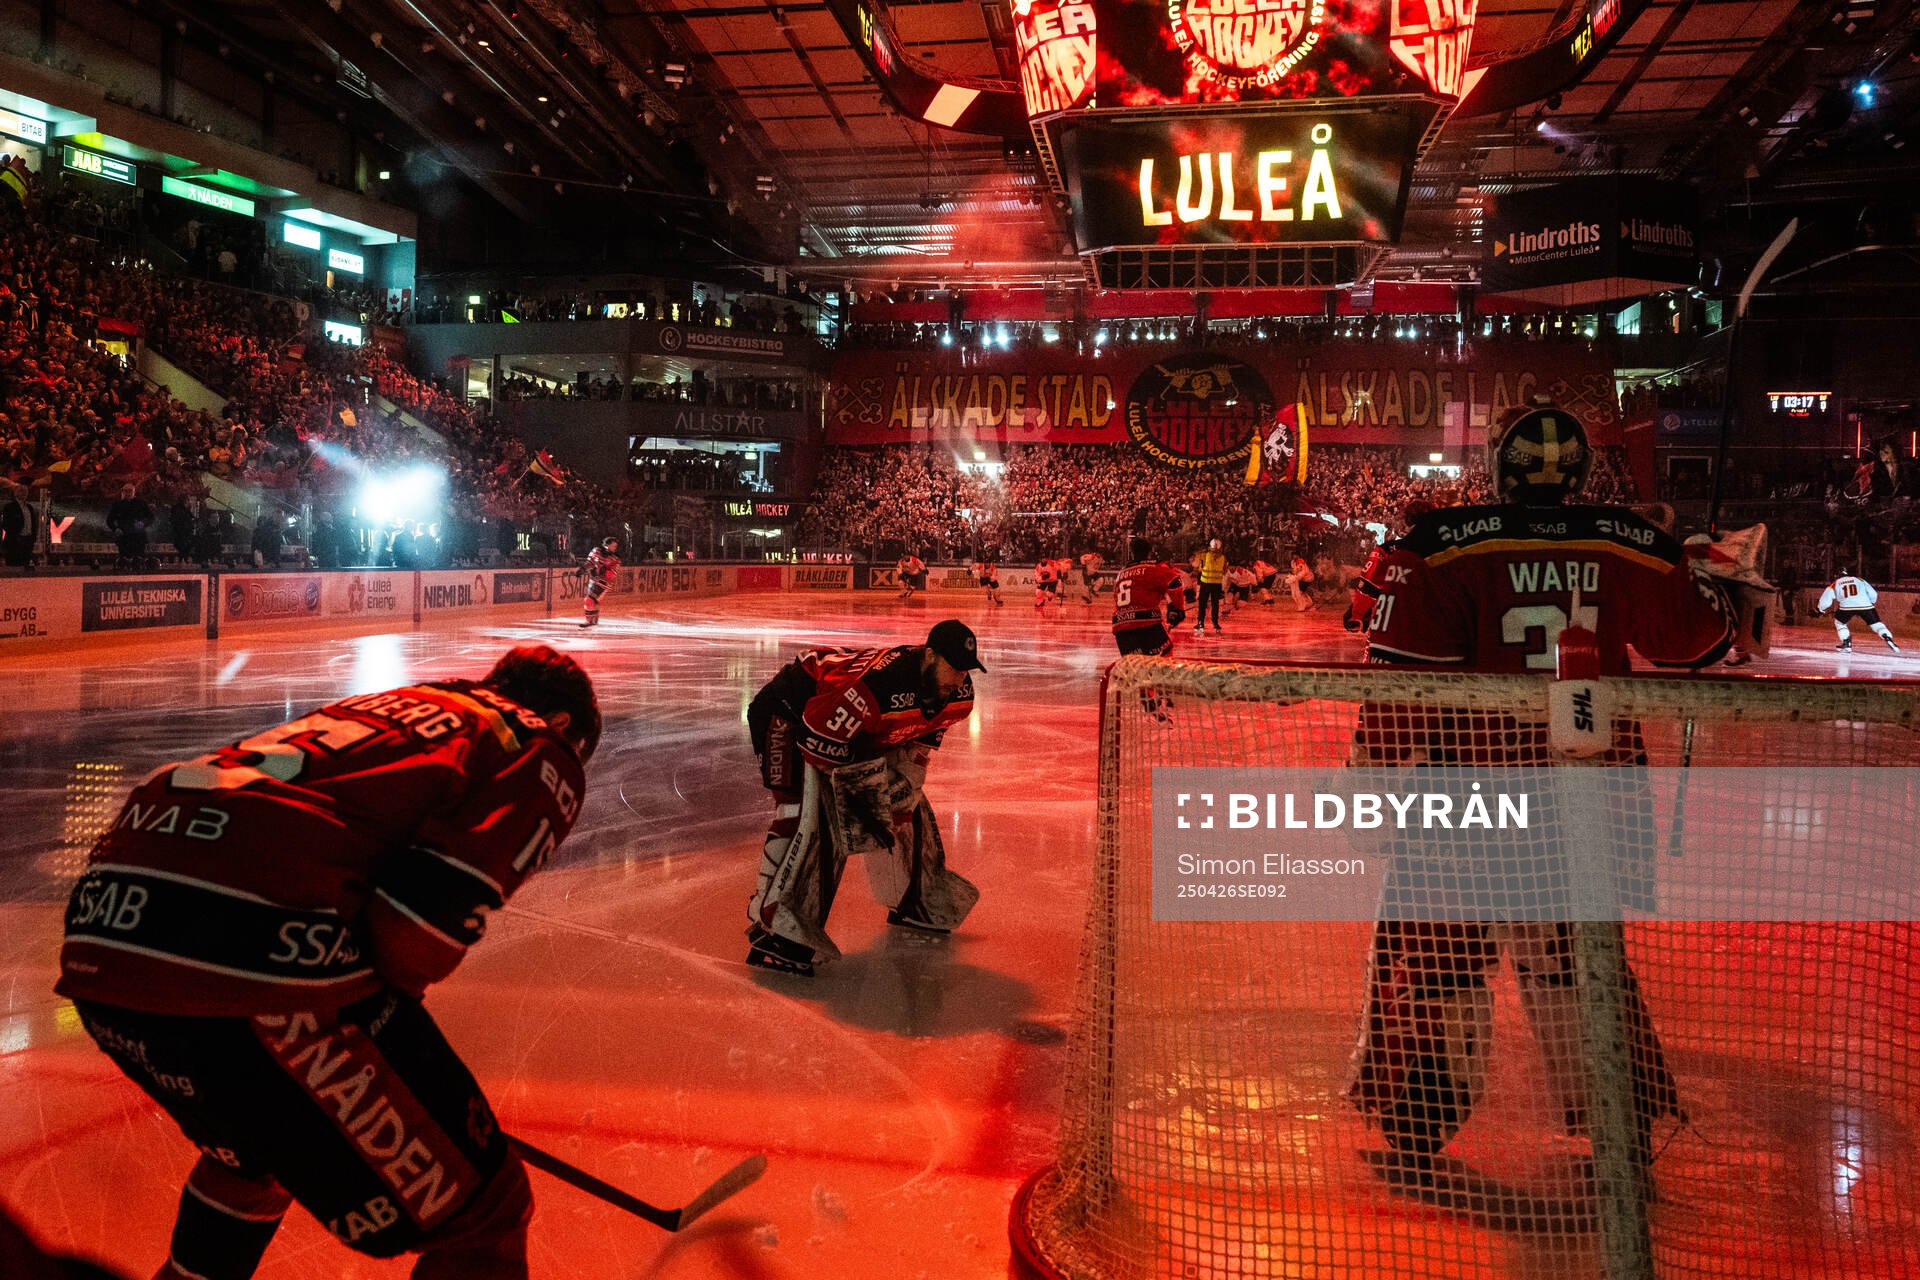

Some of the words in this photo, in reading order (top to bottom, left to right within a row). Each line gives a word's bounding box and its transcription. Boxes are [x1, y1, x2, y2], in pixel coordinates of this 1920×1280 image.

[1186, 10, 1306, 69] HOCKEY
[1187, 31, 1320, 90] HOCKEYFÖRENING
[1309, 0, 1325, 26] 197
[1021, 35, 1096, 116] OCKEY
[71, 150, 102, 174] JIAB
[1139, 123, 1342, 226] LULEÅ
[1509, 221, 1600, 255] Lindroths
[1632, 218, 1694, 247] Lindroths
[1514, 250, 1569, 264] MotorCenter
[1570, 245, 1594, 257] Luleå
[686, 332, 784, 351] HOCKEYBISTRO
[888, 362, 1027, 428] ÄLSKADE
[1036, 373, 1113, 428] STAD
[1297, 357, 1454, 427] ÄLSKADE
[1784, 396, 1814, 408] 03:17
[674, 410, 767, 434] ALLSTAR
[755, 503, 790, 517] HOCKEY
[1453, 517, 1502, 541] LKAB
[366, 578, 392, 593] Luleå
[795, 569, 847, 583] BLÅKLÄDER
[1508, 561, 1600, 593] WARD
[100, 587, 136, 605] LULEÅ
[137, 588, 187, 603] TEKNISKA
[366, 595, 396, 611] Energi
[423, 585, 456, 609] NIEMI
[457, 583, 473, 606] BIL
[1117, 580, 1132, 607] 6
[0, 606, 37, 622] BYGG
[100, 604, 167, 621] UNIVERSITET
[19, 623, 37, 638] AB
[889, 691, 916, 709] SSAB
[1572, 688, 1594, 733] SHL
[825, 705, 863, 739] 34
[112, 802, 230, 841] NAB
[287, 1037, 459, 1221] NÅIDEN
